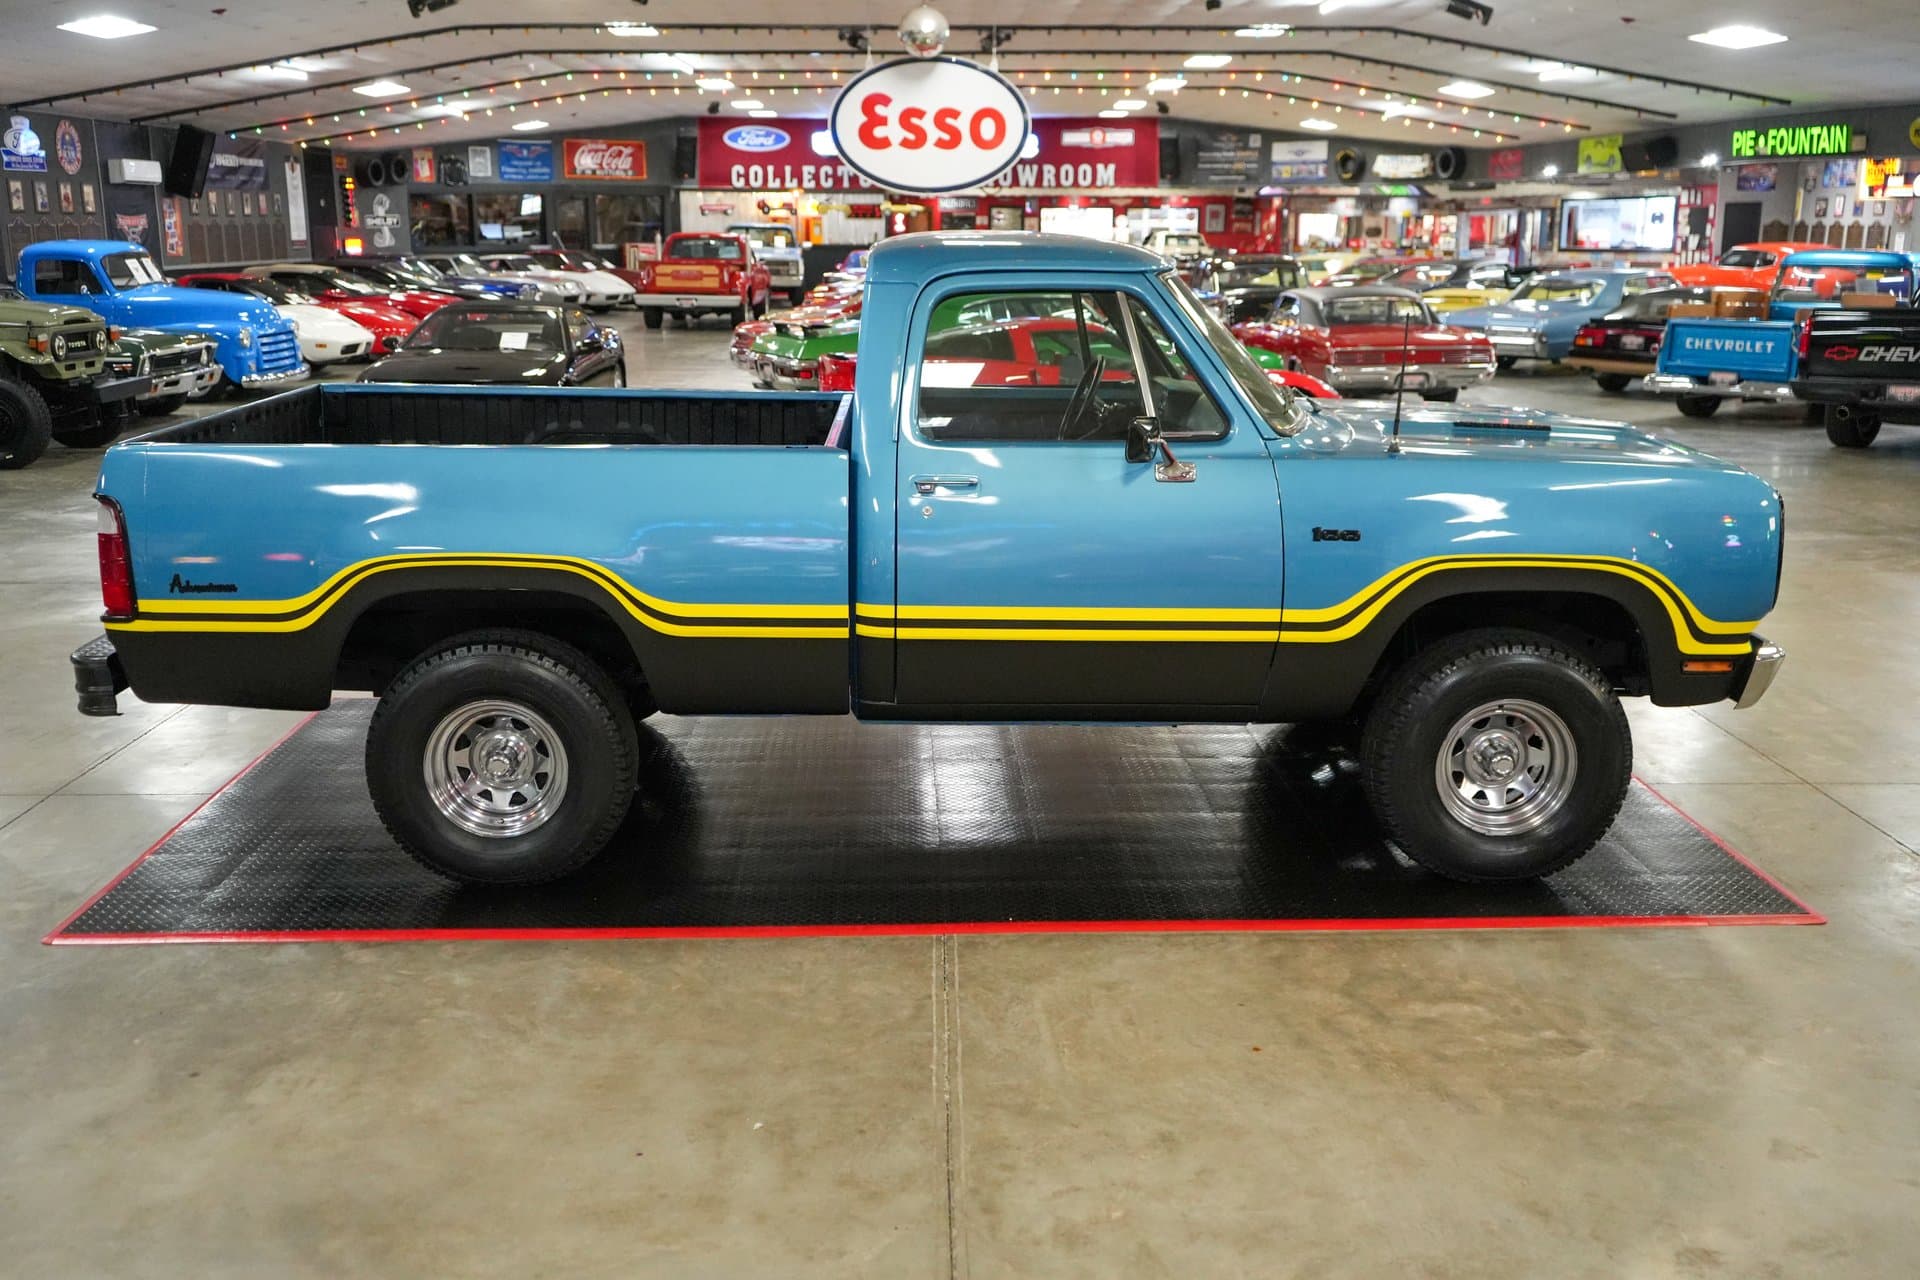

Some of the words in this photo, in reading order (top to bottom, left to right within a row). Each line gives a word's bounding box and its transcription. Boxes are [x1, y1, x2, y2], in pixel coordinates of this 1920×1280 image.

[738, 129, 776, 146] Ford
[1732, 130, 1755, 157] PIE
[1767, 124, 1847, 156] FOUNTAIN
[68, 340, 87, 348] TOYOTA
[1685, 337, 1775, 353] CHEVROLET
